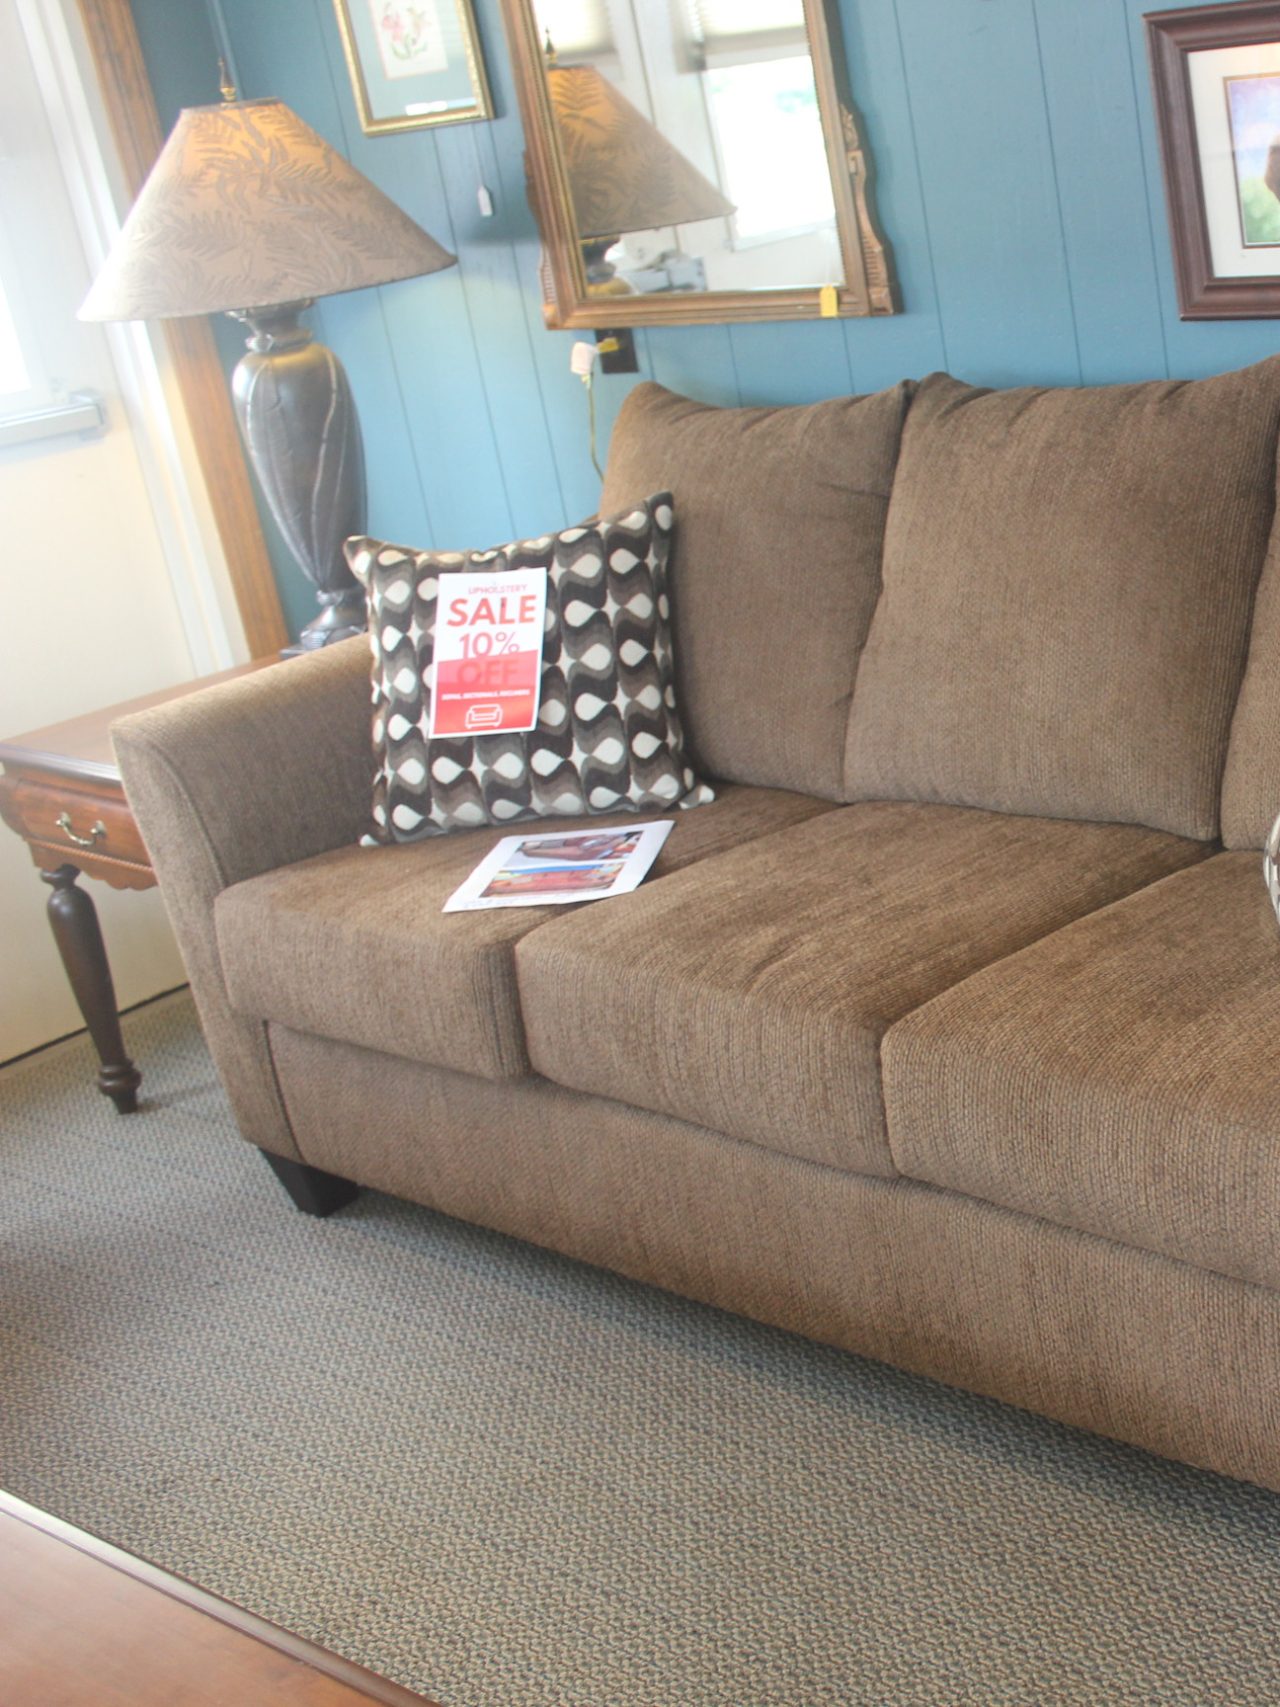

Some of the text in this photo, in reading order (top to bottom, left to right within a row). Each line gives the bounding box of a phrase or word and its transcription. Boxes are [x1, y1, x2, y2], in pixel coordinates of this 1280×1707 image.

[468, 584, 528, 595] UPHOLSTERY
[447, 595, 537, 627] SALE
[460, 631, 519, 659] 10%
[457, 660, 519, 684] OFF
